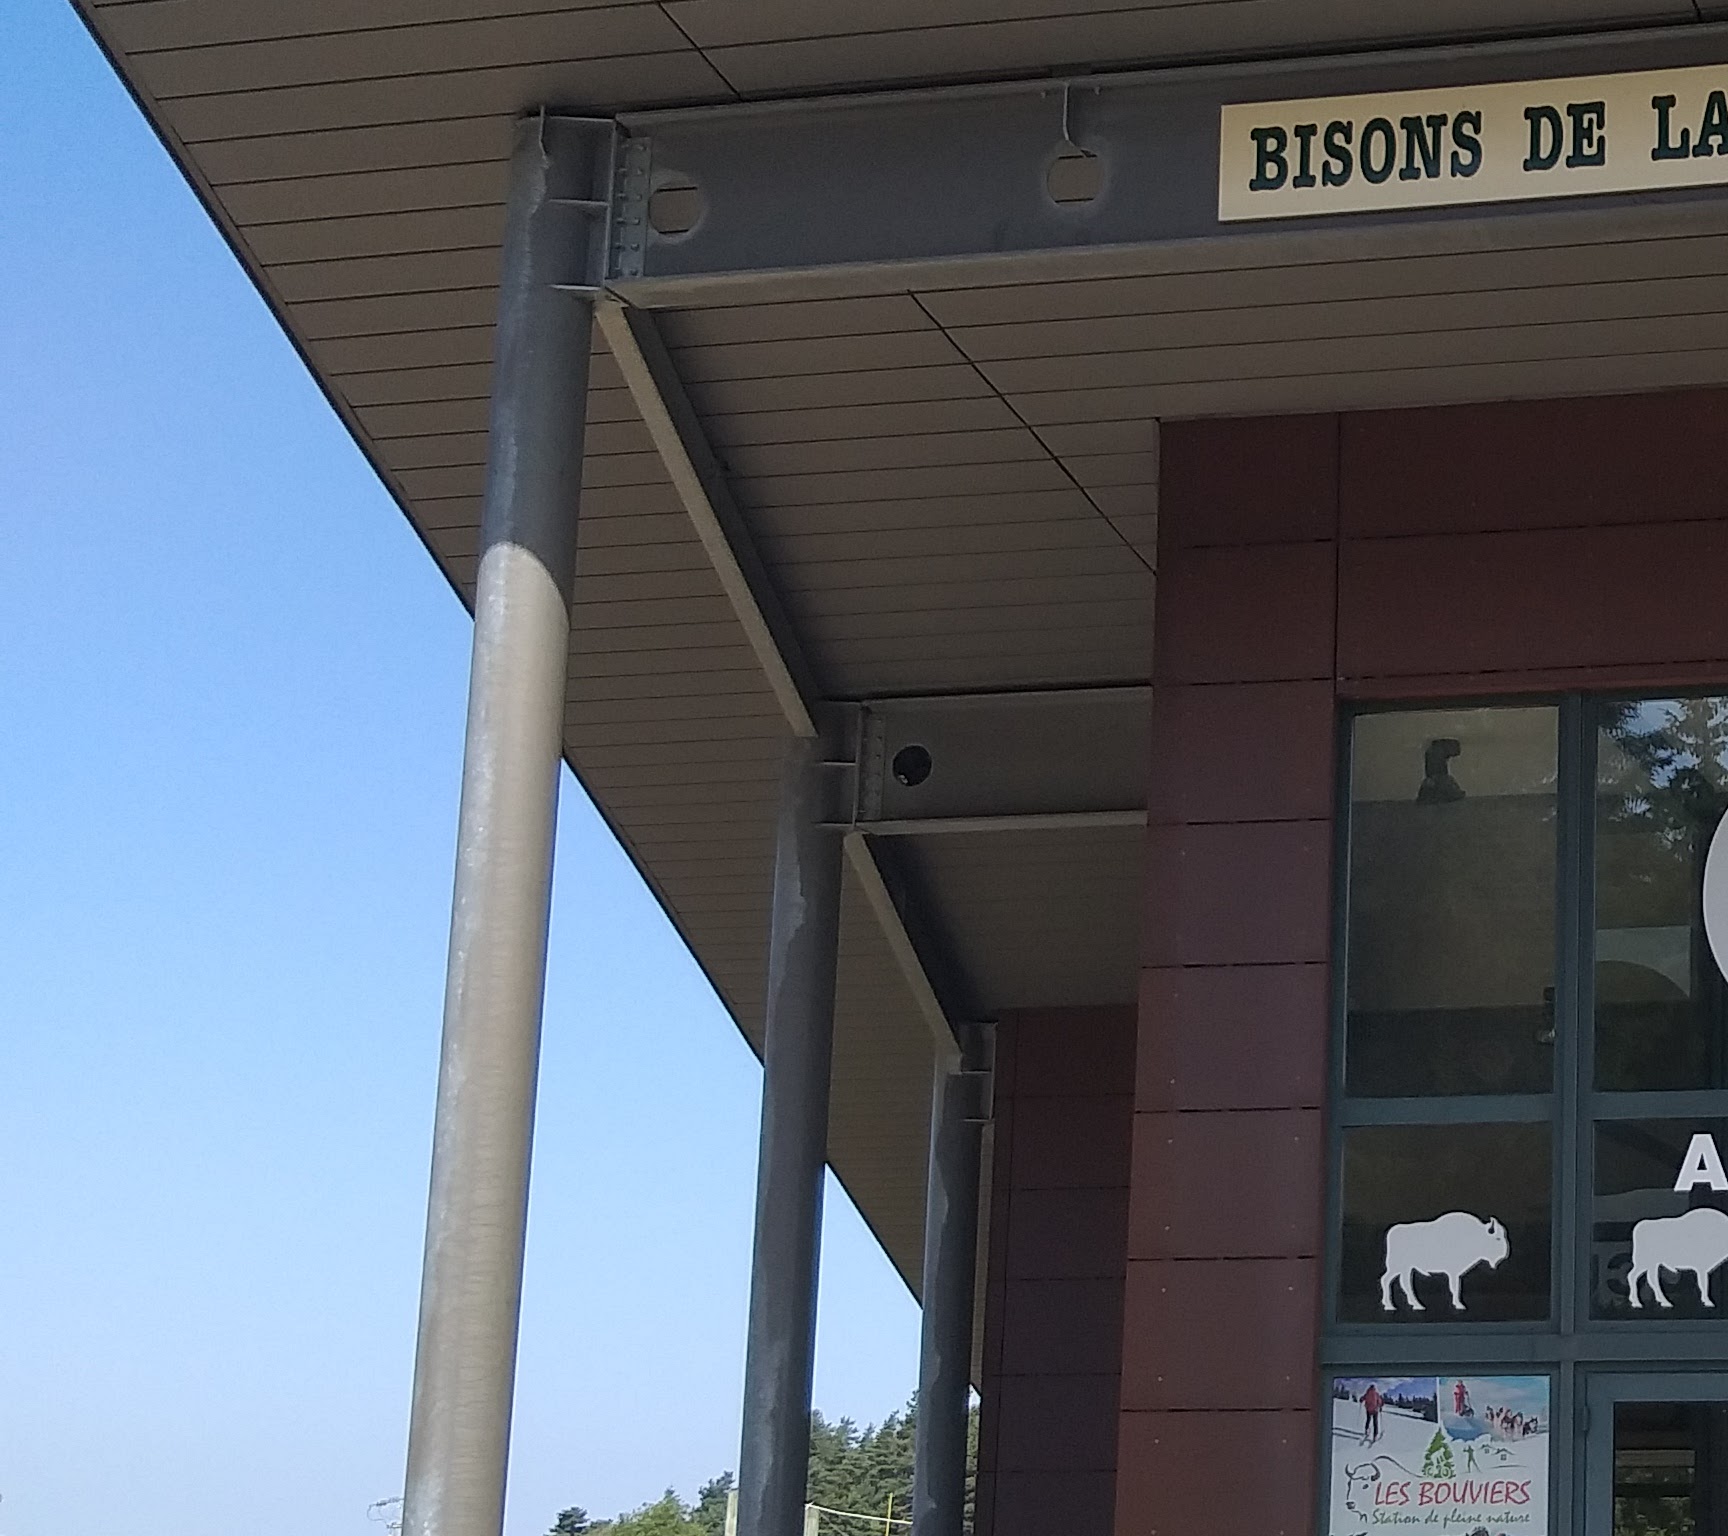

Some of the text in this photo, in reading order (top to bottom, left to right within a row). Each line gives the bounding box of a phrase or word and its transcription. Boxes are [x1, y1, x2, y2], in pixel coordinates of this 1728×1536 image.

[1249, 110, 1484, 191] BISONS
[1523, 101, 1606, 173] DE
[1375, 1480, 1532, 1505] LES BOUVIERS
[1372, 1510, 1529, 1528] Station de pleine nature
